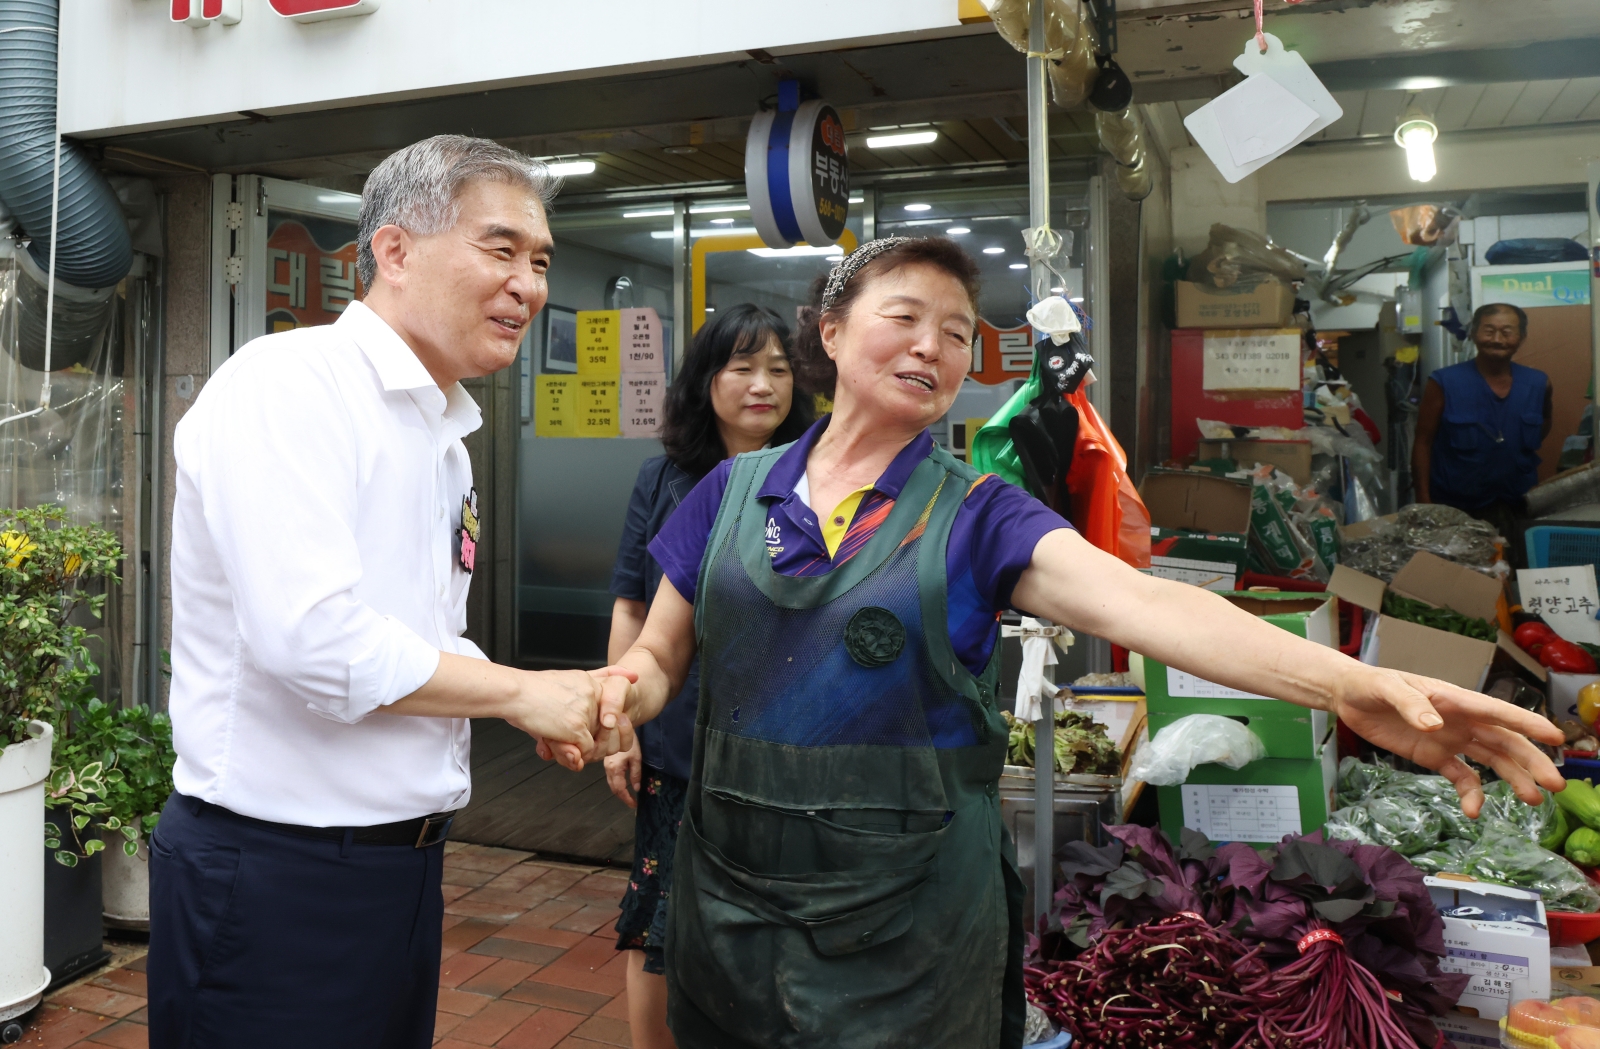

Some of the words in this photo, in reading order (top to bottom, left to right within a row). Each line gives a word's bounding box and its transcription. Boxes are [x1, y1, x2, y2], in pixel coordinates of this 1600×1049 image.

[266, 246, 356, 313] 대림
[1502, 275, 1553, 293] Dual
[629, 352, 655, 361] 1천/90
[586, 418, 611, 427] 32.5억
[631, 418, 656, 427] 12.6억
[1529, 596, 1594, 616] 청양고추
[1472, 986, 1511, 995] 010-7110-
